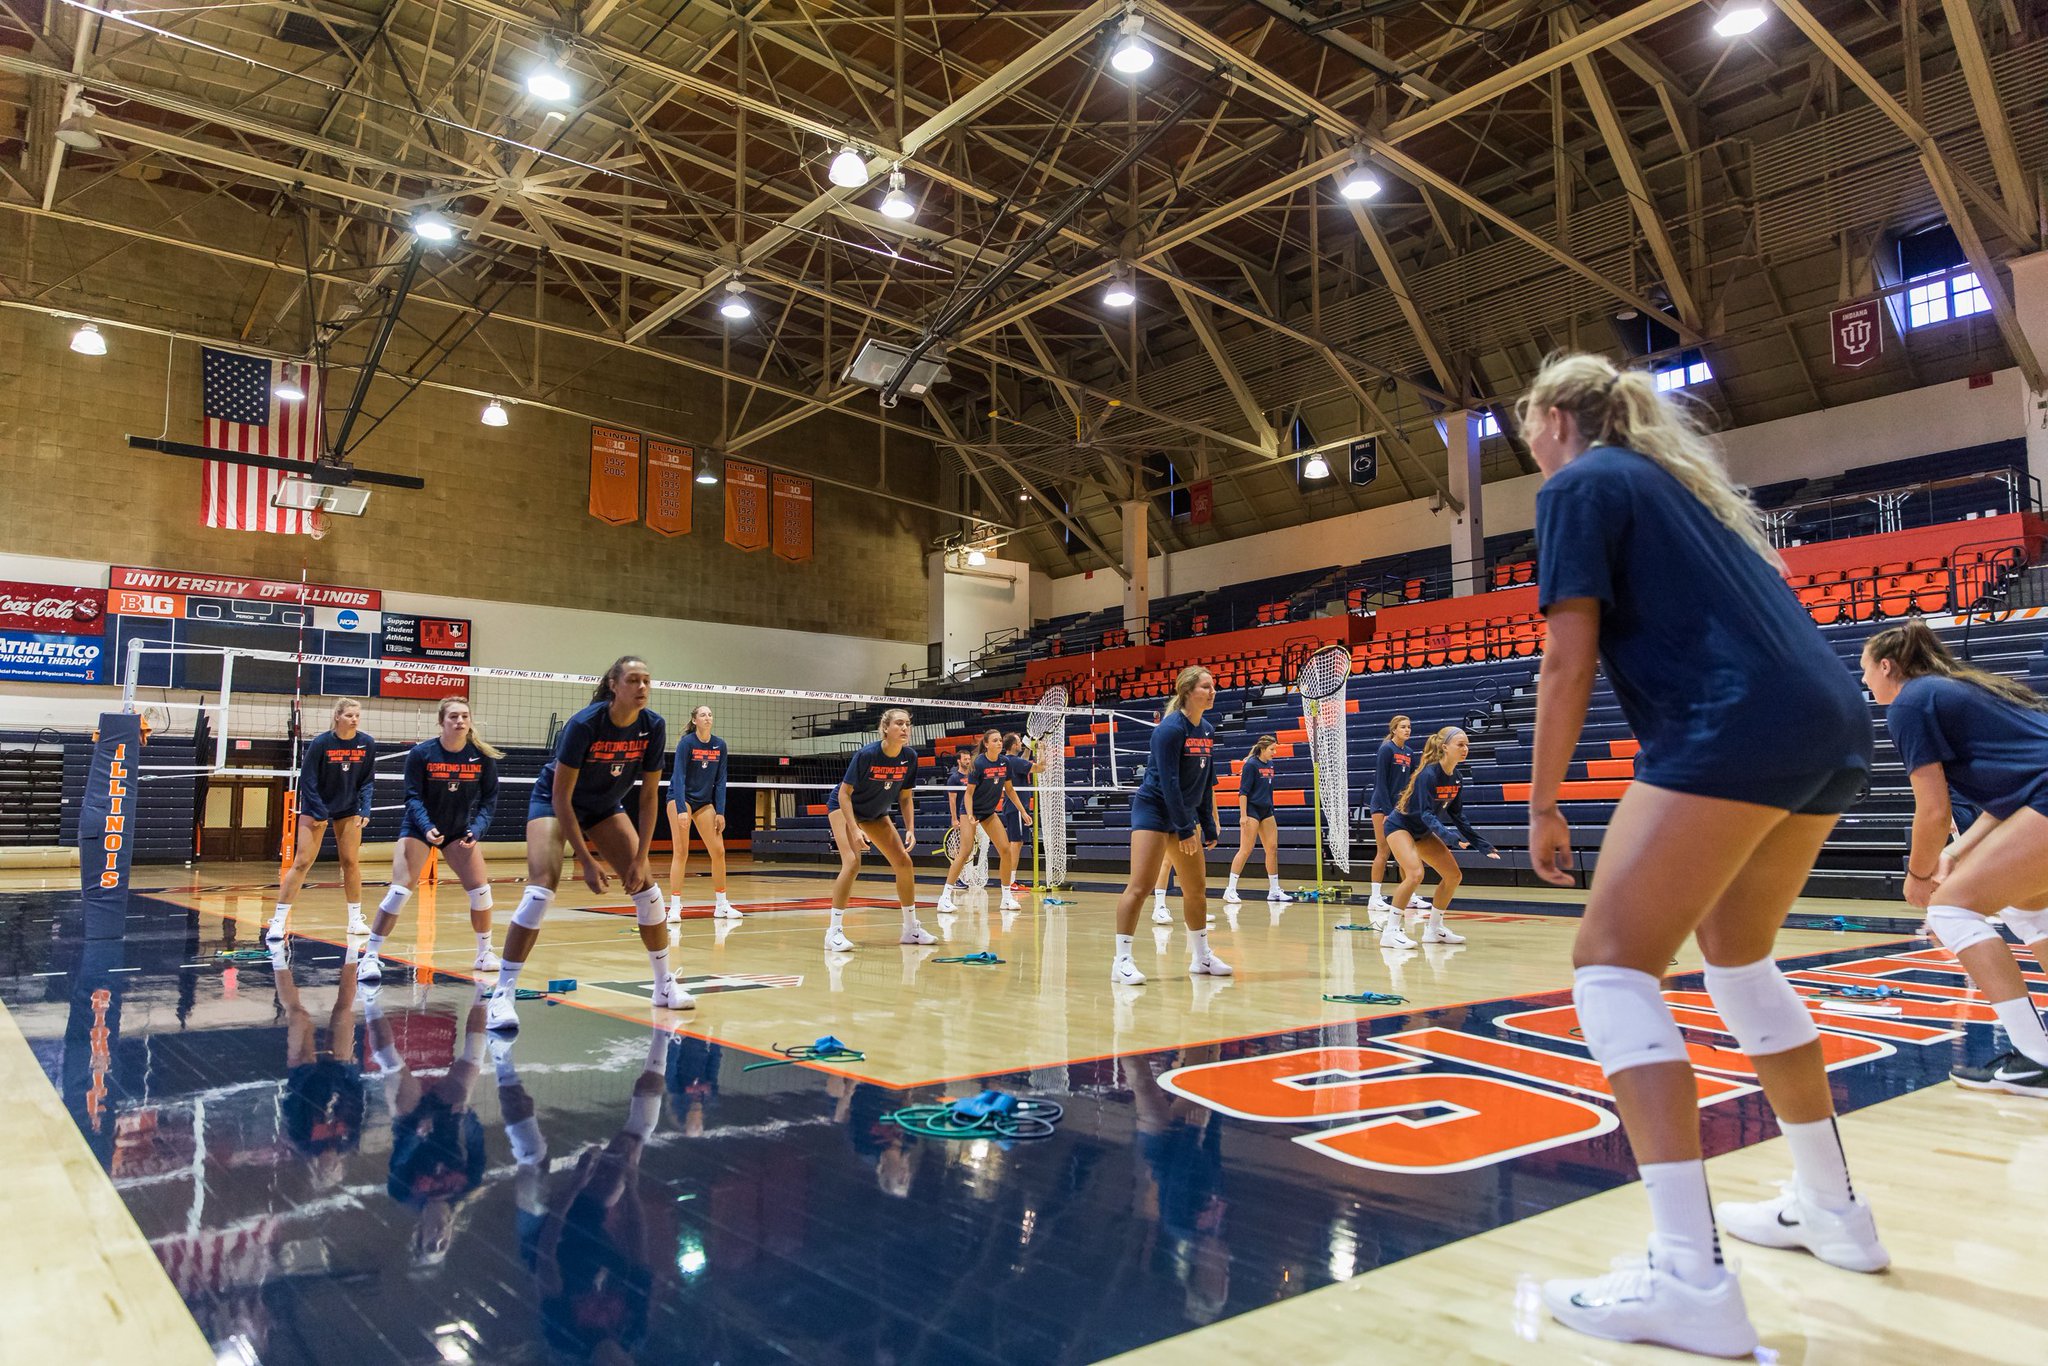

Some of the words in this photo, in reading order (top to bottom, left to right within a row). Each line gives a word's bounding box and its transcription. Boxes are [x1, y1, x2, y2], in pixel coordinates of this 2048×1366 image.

[592, 430, 639, 442] ILLINOIS
[649, 444, 692, 456] ILLINOIS
[605, 456, 625, 466] 1952
[604, 466, 626, 477] 2005
[726, 463, 768, 475] ILLINOIS
[774, 476, 812, 488] ILLINOIS
[124, 572, 250, 594] UNIVERSITY
[260, 584, 286, 597] OF
[296, 588, 369, 605] ILLINOIS
[387, 617, 414, 626] Support
[0, 638, 100, 658] ATHLETICO
[426, 649, 465, 657] ILLINICARD.ORG
[48, 656, 92, 666] THERAPY
[290, 654, 335, 662] FIGHTING
[394, 662, 436, 671] FIGHTING
[490, 669, 528, 677] FIGHTING
[590, 741, 628, 751] FIGHTING
[427, 763, 460, 772] FIGHTING
[461, 764, 481, 772] ILLINI
[100, 743, 127, 888] ILLINOIS
